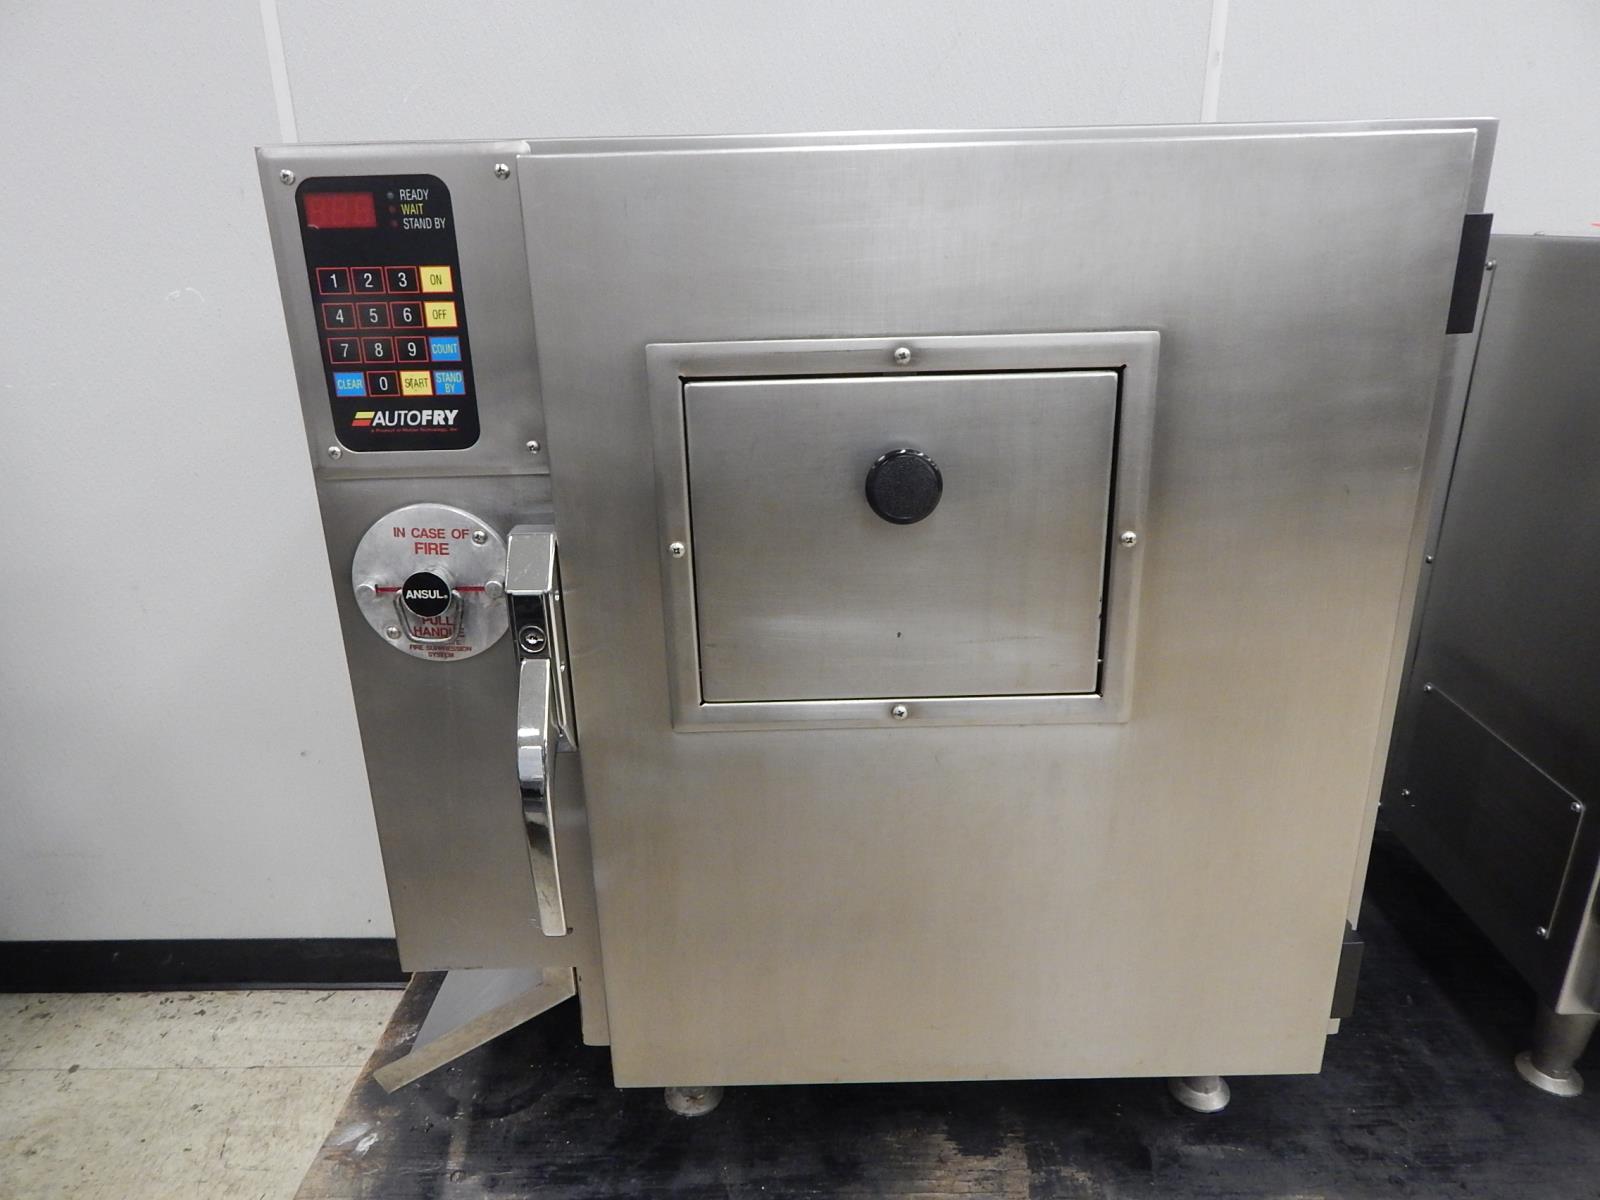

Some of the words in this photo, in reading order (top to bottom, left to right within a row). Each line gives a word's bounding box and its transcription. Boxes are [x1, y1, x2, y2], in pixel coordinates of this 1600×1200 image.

[399, 188, 429, 201] READY
[401, 203, 424, 215] WAIT
[403, 217, 432, 230] STAND
[434, 217, 446, 229] BY
[330, 273, 338, 289] 1
[363, 272, 374, 288] 2
[398, 271, 408, 288] 3
[429, 273, 443, 286] ON
[335, 308, 344, 324] 4
[369, 307, 379, 323] 5
[402, 307, 413, 323] 6
[432, 308, 447, 321] OFF
[340, 343, 349, 358] 7
[374, 342, 384, 357] 8
[407, 341, 417, 357] 9
[431, 343, 458, 355] COUNT
[337, 379, 363, 390] CLEAR
[379, 376, 388, 391] 0
[404, 377, 429, 389] START
[435, 371, 462, 383] STAND
[444, 383, 455, 393] BY
[372, 409, 459, 426] AUTOFRY
[393, 527, 406, 538] IN
[411, 527, 446, 540] CASE
[451, 528, 470, 540] OF
[414, 541, 450, 556] FIRE
